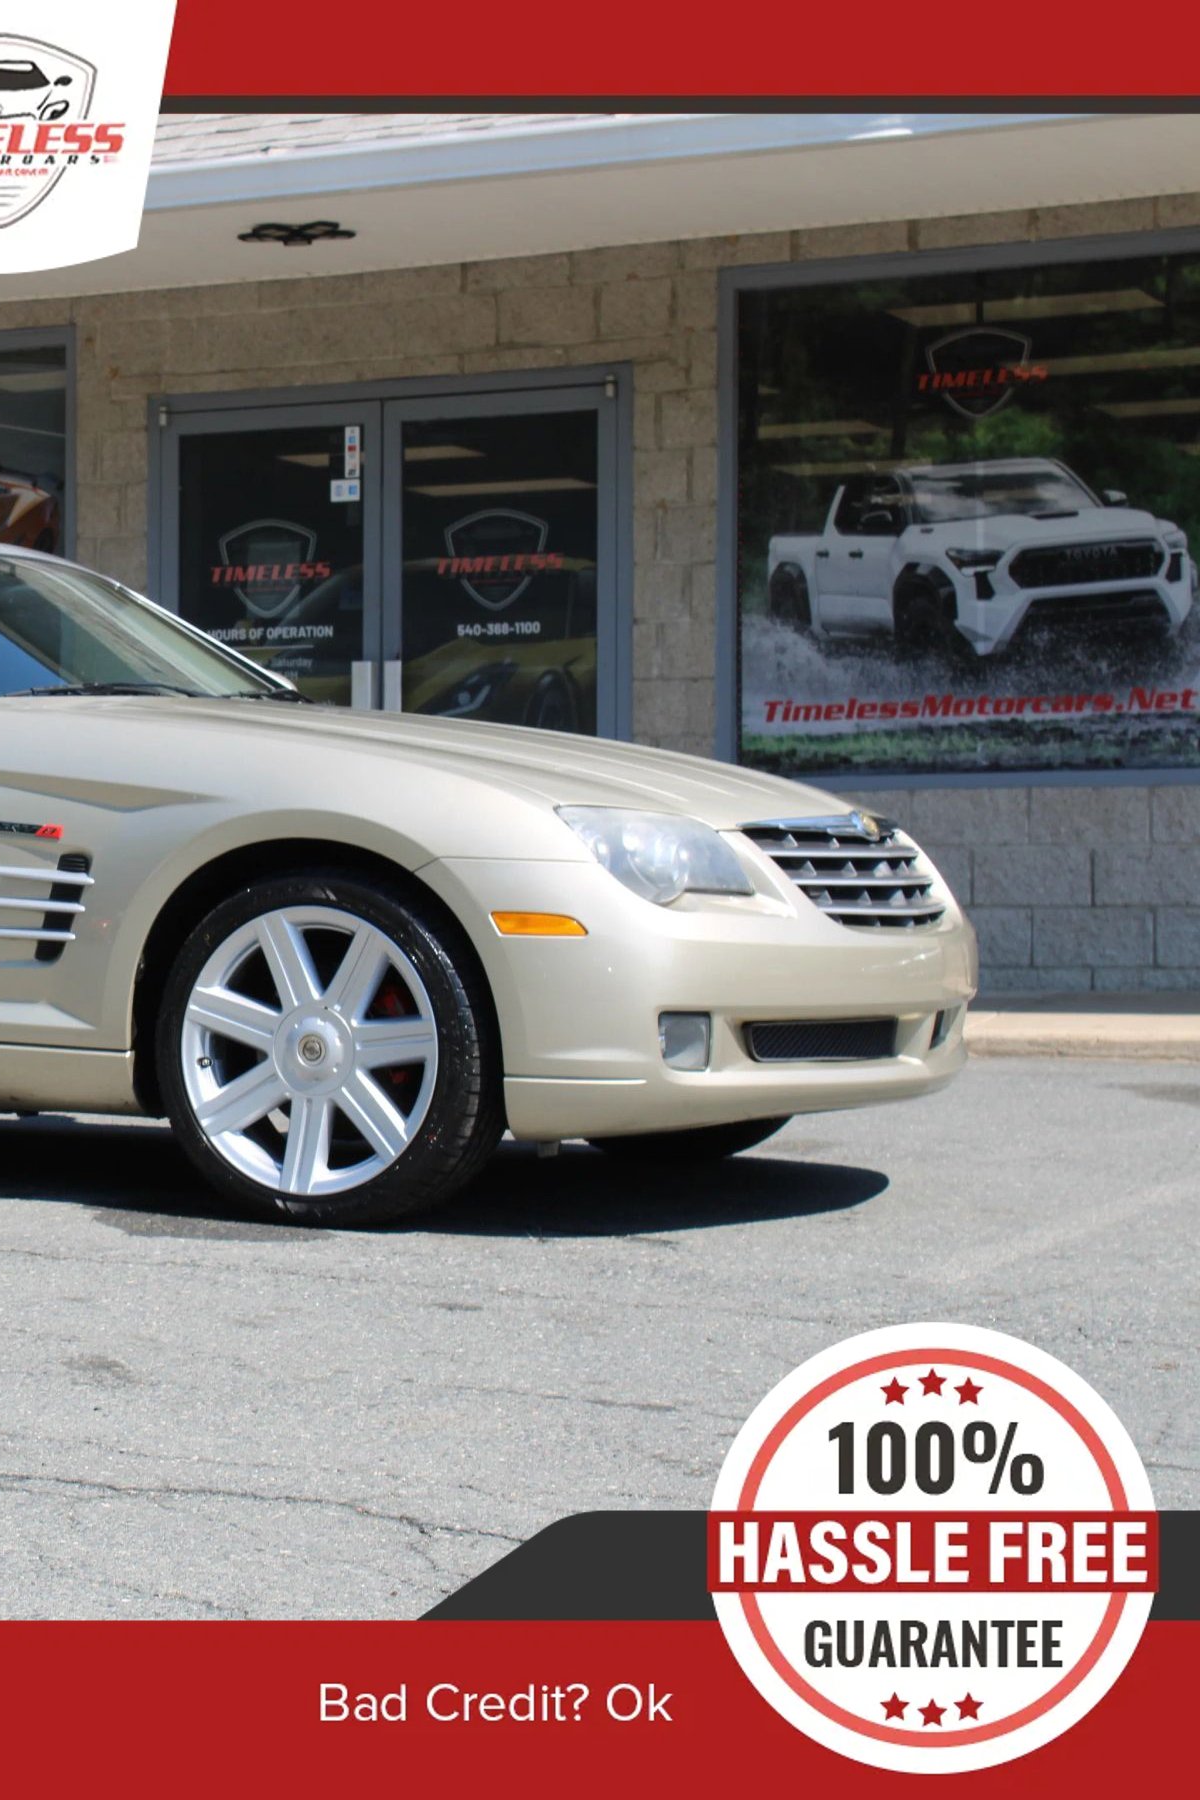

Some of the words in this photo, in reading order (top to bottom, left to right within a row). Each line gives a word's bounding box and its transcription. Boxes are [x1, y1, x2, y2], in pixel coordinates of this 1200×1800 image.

[916, 366, 1049, 391] TIMELESS
[211, 561, 331, 584] TIMELESS
[437, 553, 563, 575] TIMELESS
[207, 627, 247, 641] HOURS
[249, 627, 265, 640] OF
[266, 625, 334, 639] OPERATION
[763, 687, 1197, 723] TimelessMotorcars.Net
